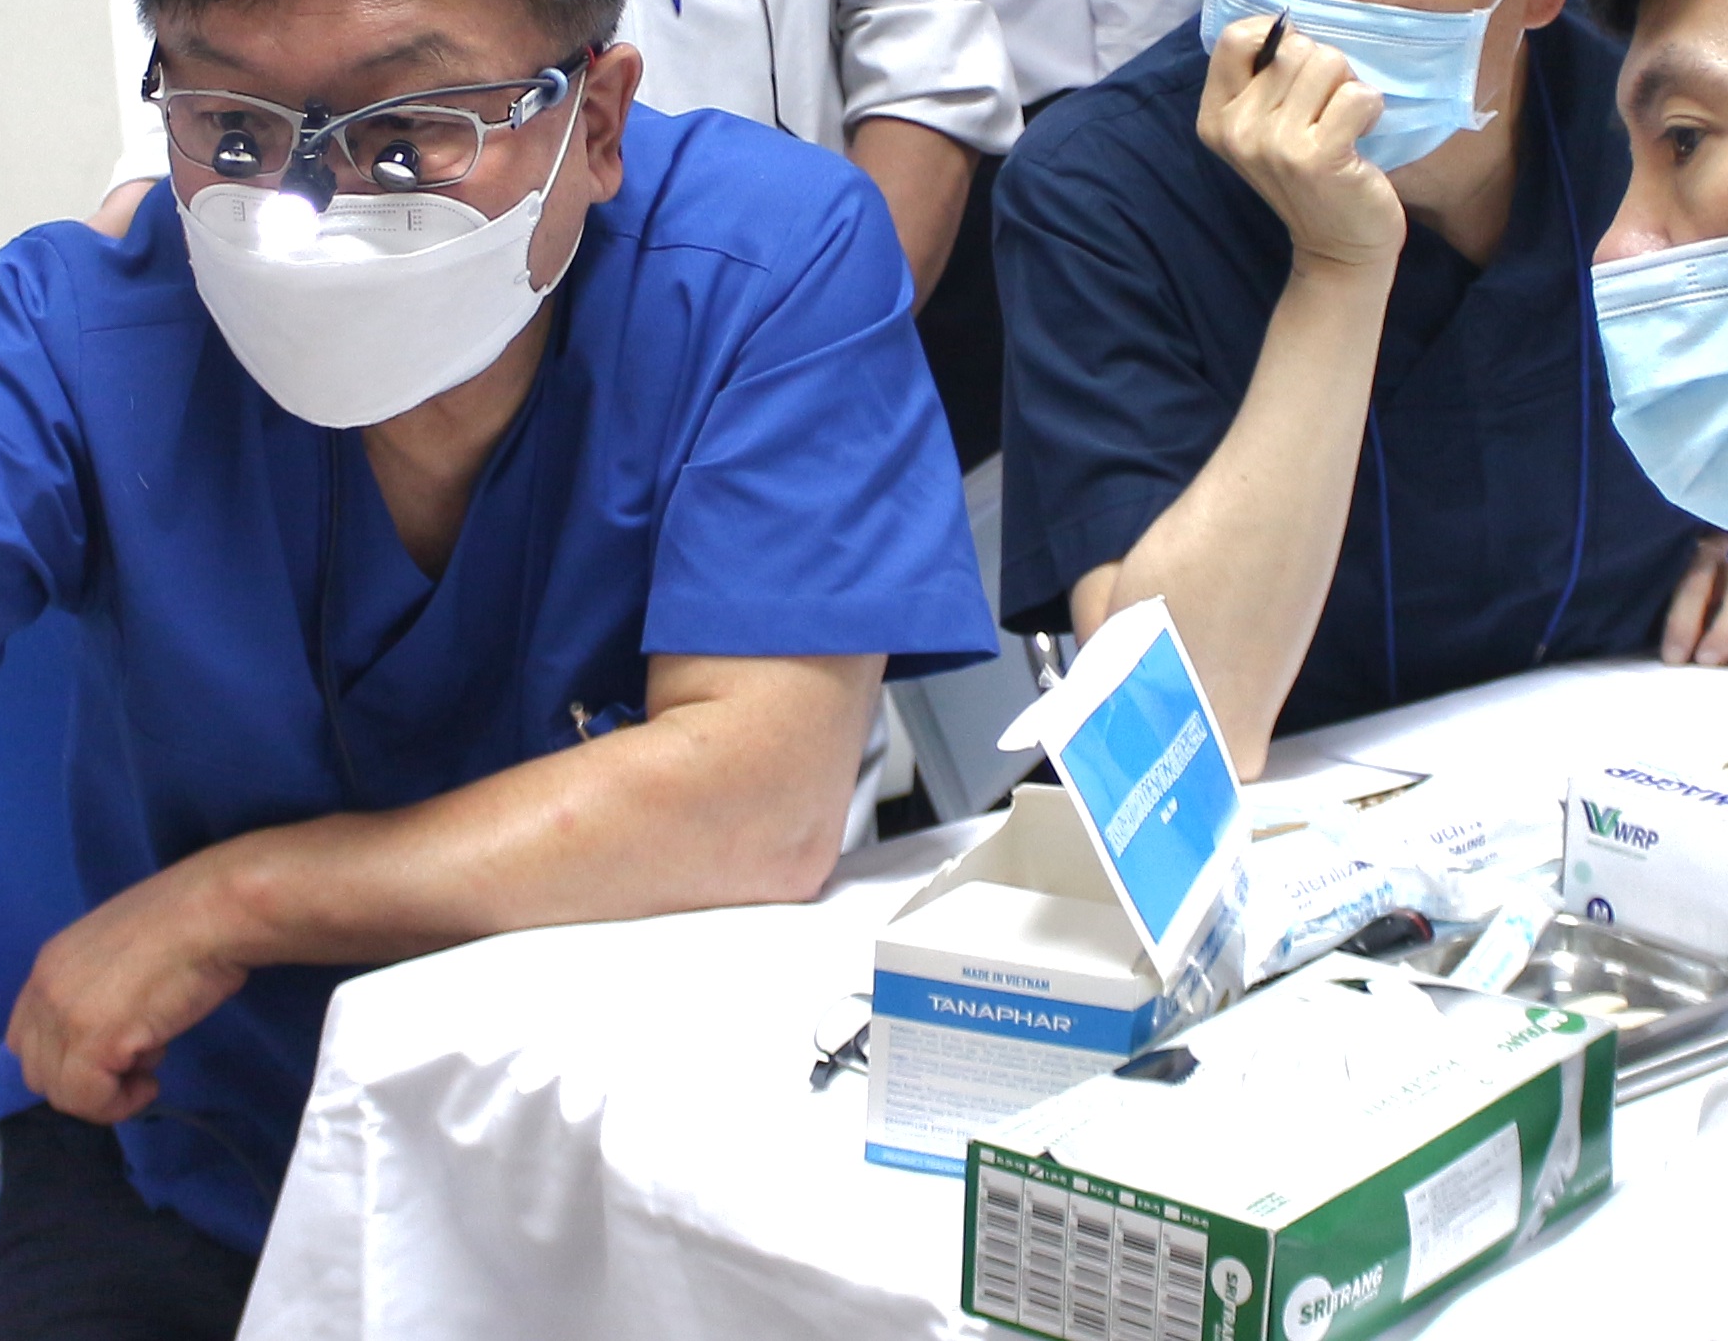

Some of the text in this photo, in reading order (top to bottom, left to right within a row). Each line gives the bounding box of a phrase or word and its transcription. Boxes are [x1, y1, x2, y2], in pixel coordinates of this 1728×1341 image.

[1614, 821, 1660, 850] WRP
[962, 966, 1051, 992] MADE IN VIETNAM
[928, 993, 1073, 1033] TANAPHAR
[1298, 1263, 1384, 1326] SRITRANG
